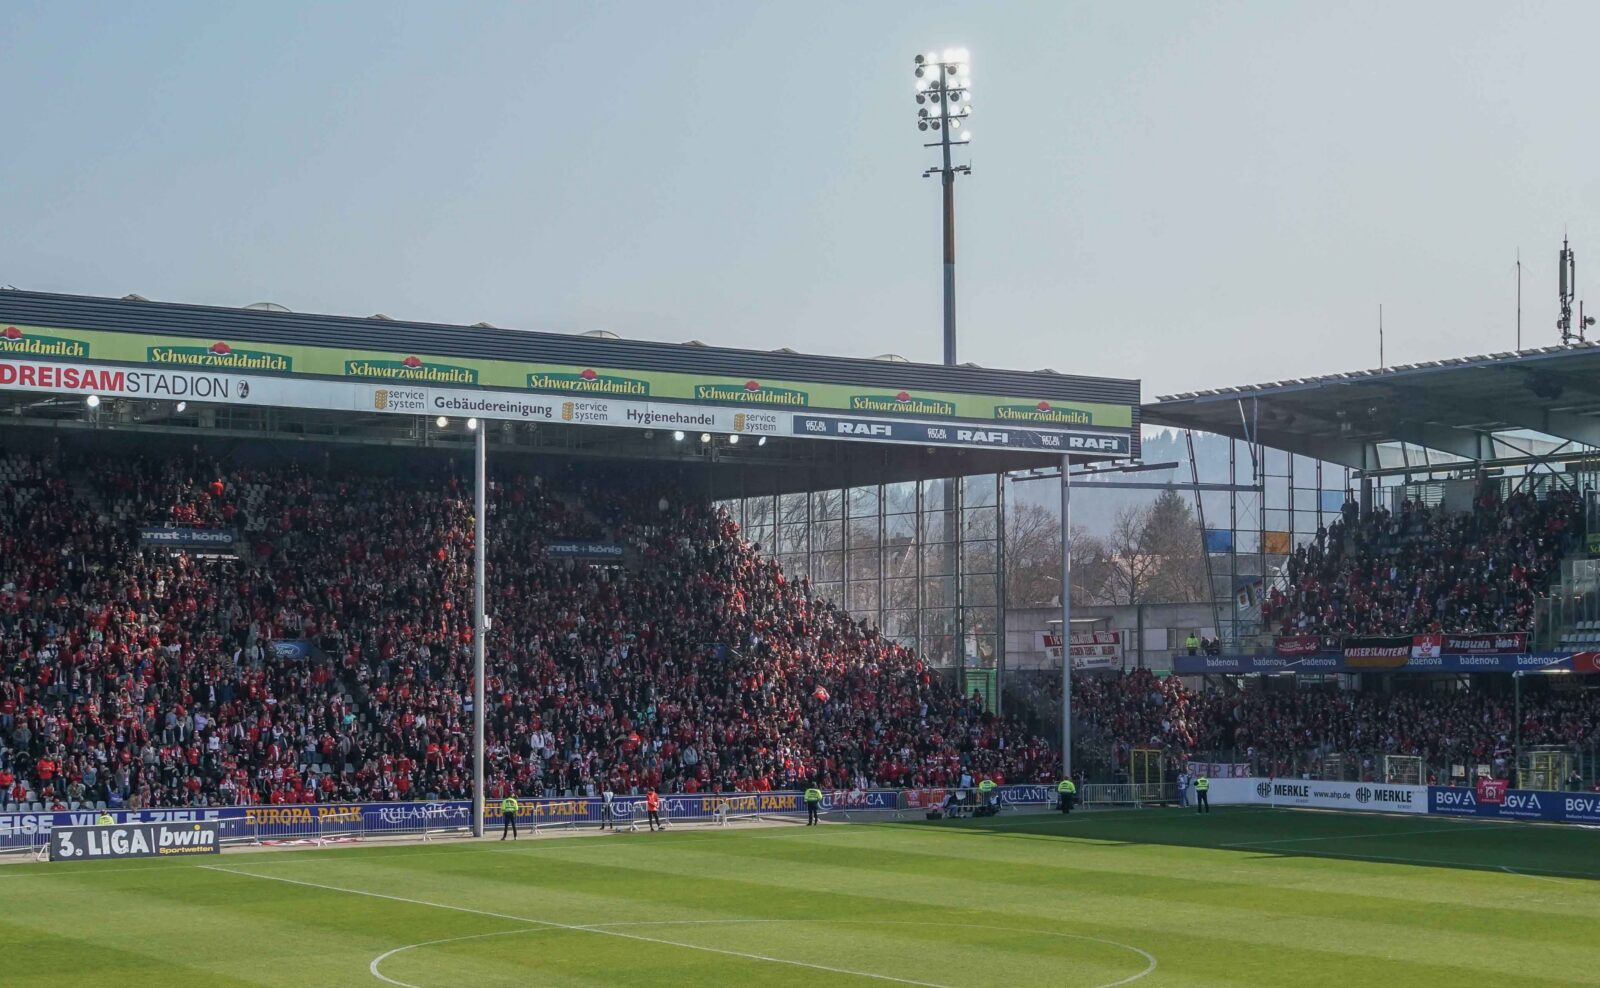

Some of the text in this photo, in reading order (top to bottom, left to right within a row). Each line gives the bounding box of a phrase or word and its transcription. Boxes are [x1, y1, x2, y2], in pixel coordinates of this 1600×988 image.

[152, 348, 287, 370] Schwarzwaldmilch
[350, 362, 473, 383] Schwarzwaldmilch
[531, 375, 645, 394] Schwarzwaldmilch
[388, 390, 425, 400] service
[699, 386, 804, 405] Schwarzwaldmilch
[388, 400, 425, 410] system
[434, 397, 553, 418] Gebäudereinigung
[575, 402, 608, 412] service
[853, 397, 952, 415] Schwarzwaldmilch
[575, 411, 608, 421] system
[627, 409, 715, 426] Hygienehandel
[746, 413, 776, 423] service
[997, 407, 1089, 424] Schwarzwaldmilch
[746, 422, 776, 432] system
[837, 422, 892, 436] RAFI
[957, 429, 1009, 443] RAFI
[1069, 437, 1119, 450] RAFI
[191, 532, 233, 543] könig
[1344, 646, 1409, 658] KAISERSLAUTERN
[1206, 657, 1239, 667] badenova
[1252, 656, 1287, 666] badenova
[1301, 656, 1337, 666] badenova
[1459, 655, 1500, 665] badenova
[1517, 655, 1559, 665] badenova
[1274, 785, 1309, 797] MERKLE
[1313, 791, 1351, 800] www.ahp.de
[1374, 789, 1412, 803] MERKLE
[483, 800, 589, 818] EUOPA PARK
[760, 794, 797, 810] PARK
[245, 805, 363, 825] EUROPA PARK
[379, 802, 466, 824] RULANTICA
[0, 814, 54, 835] EISE
[70, 812, 142, 825] VILE
[159, 824, 215, 846] bwin
[58, 829, 150, 857] 3. LIGA
[159, 845, 214, 854] Sportwetten
